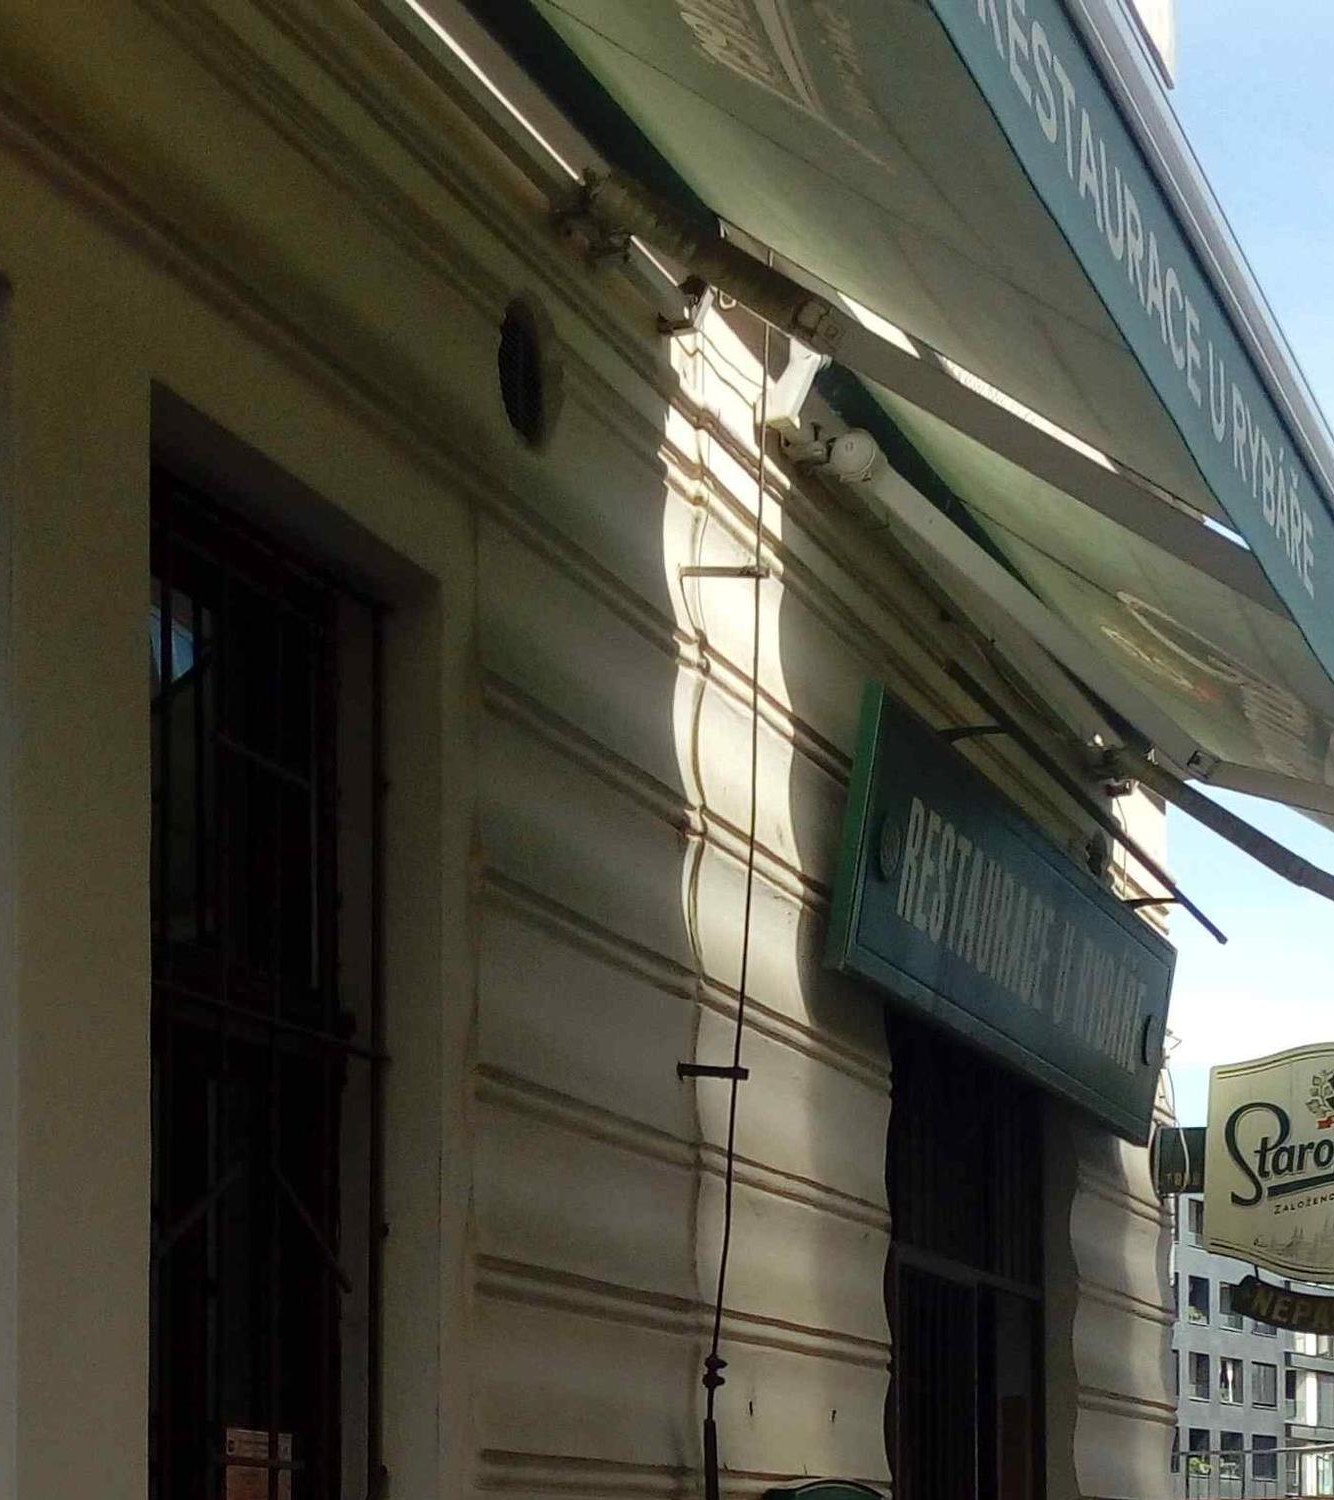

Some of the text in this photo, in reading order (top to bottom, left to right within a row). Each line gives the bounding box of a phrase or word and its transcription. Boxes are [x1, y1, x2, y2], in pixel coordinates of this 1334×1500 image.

[1208, 341, 1226, 443] U
[1232, 382, 1314, 600] RYBÁŘE
[896, 796, 1055, 1012] RESTAURACE
